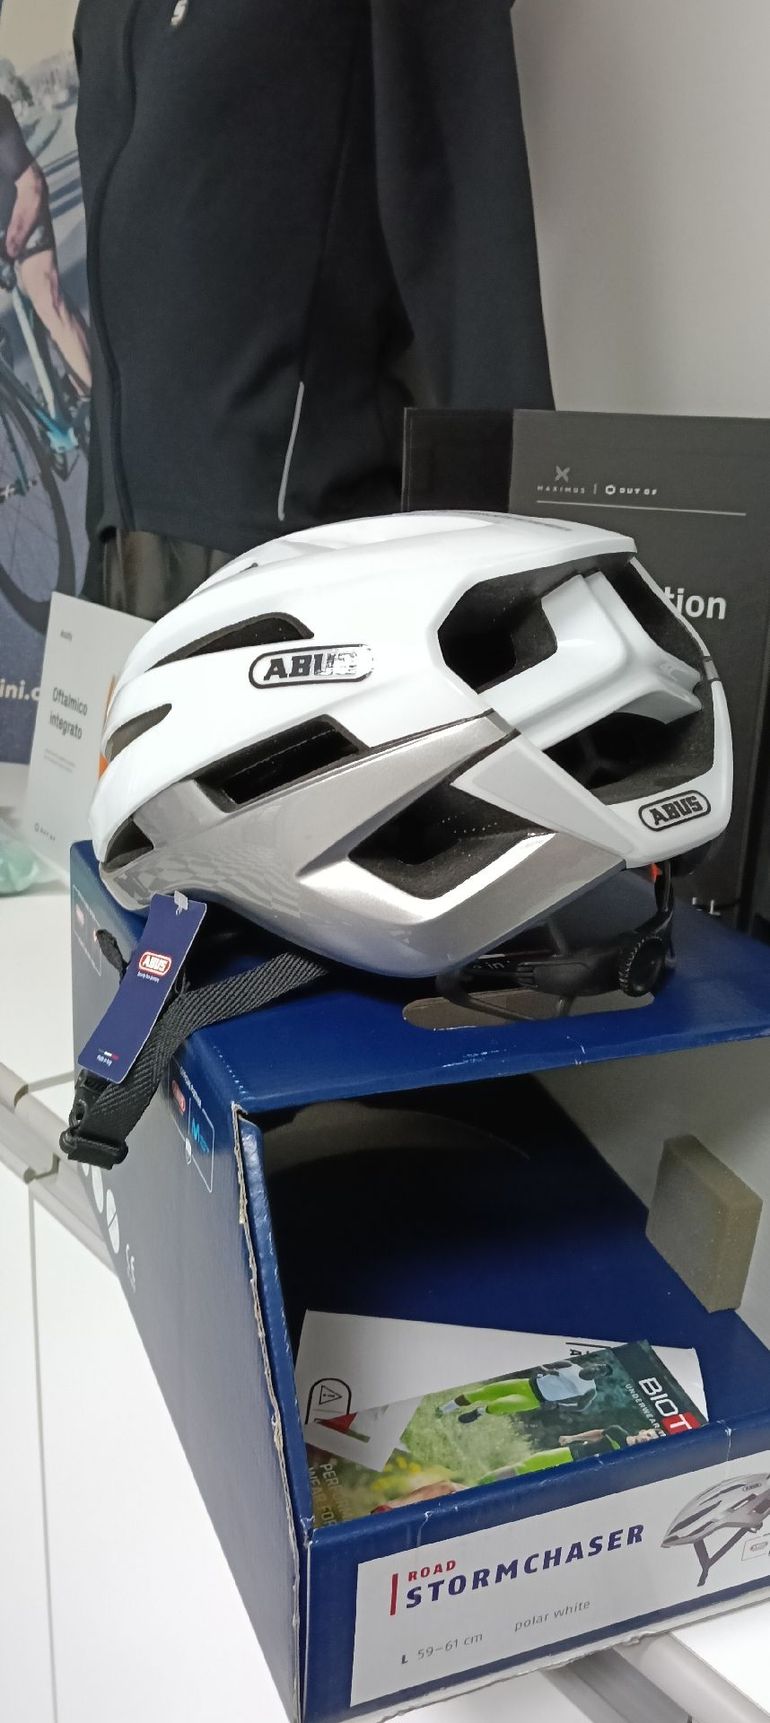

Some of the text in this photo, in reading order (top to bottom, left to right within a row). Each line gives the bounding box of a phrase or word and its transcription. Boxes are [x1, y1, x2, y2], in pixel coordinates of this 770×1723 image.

[537, 484, 585, 494] MAXIMUS
[52, 686, 88, 717] Oftalmico
[49, 710, 83, 740] integrato
[649, 795, 703, 825] ABUS
[141, 955, 168, 972] ABUS
[624, 1383, 661, 1430] UNDERWEAR
[406, 1524, 644, 1609] STORMCHASER
[408, 1560, 456, 1582] ROAD
[514, 1600, 591, 1632] polar white
[401, 1653, 408, 1665] L
[463, 1632, 484, 1646] cm
